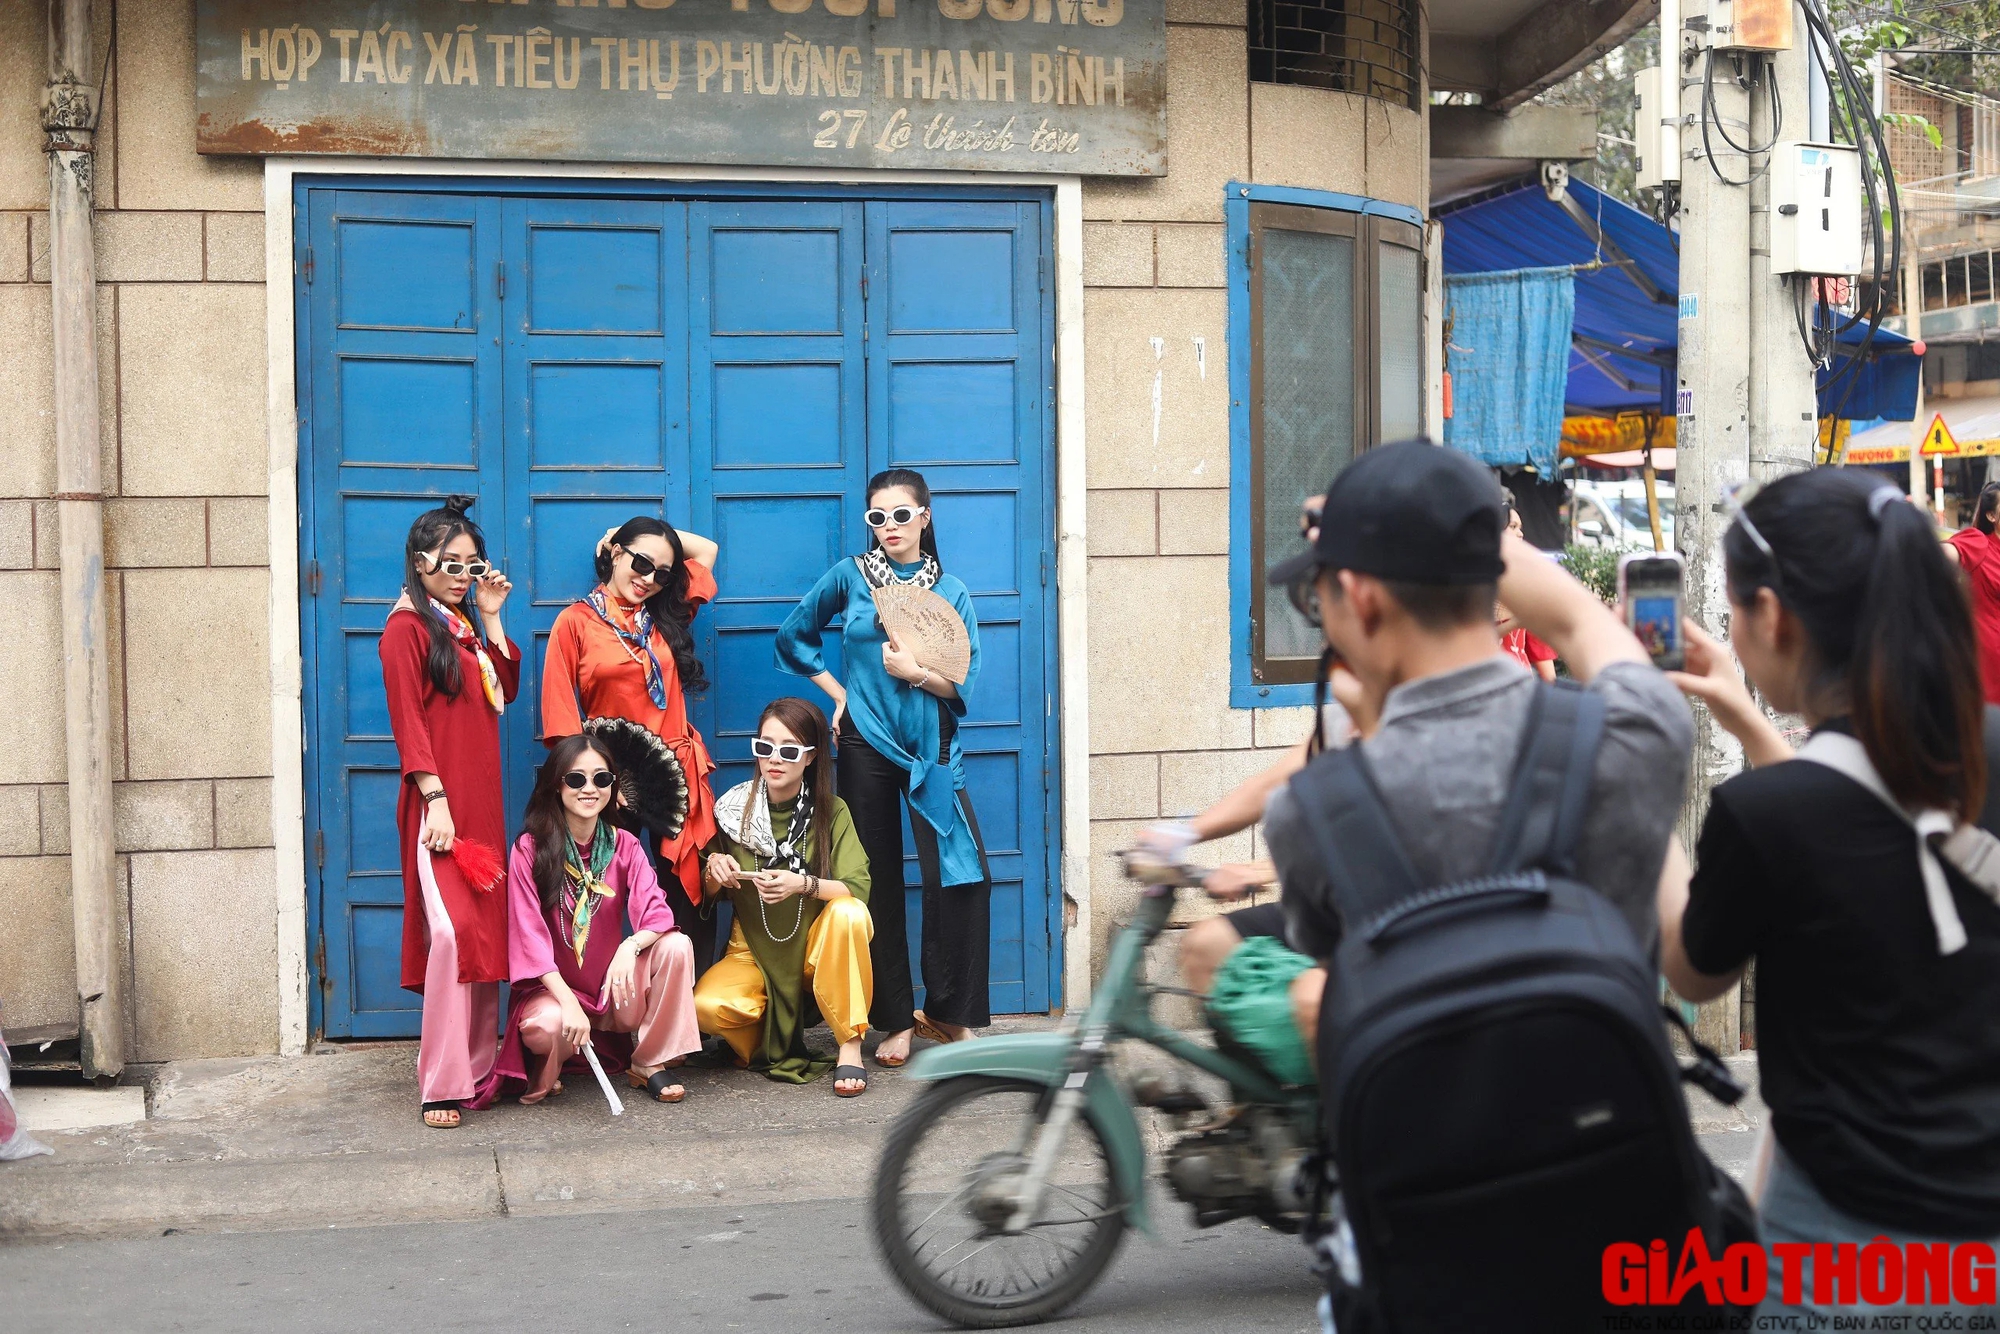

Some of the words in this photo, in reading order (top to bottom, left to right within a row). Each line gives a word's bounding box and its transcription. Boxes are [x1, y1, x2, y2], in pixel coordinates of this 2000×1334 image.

[241, 23, 322, 91] HỢP
[329, 21, 412, 84] TÁC
[424, 24, 478, 86] XÃ
[486, 26, 580, 89] TIÊU
[591, 37, 680, 100] THỤ
[696, 31, 863, 98] PHƯỜNG
[875, 47, 1015, 102] THANH
[1030, 45, 1125, 107] BÌNH
[813, 109, 868, 148] 27
[874, 107, 912, 152] Lê
